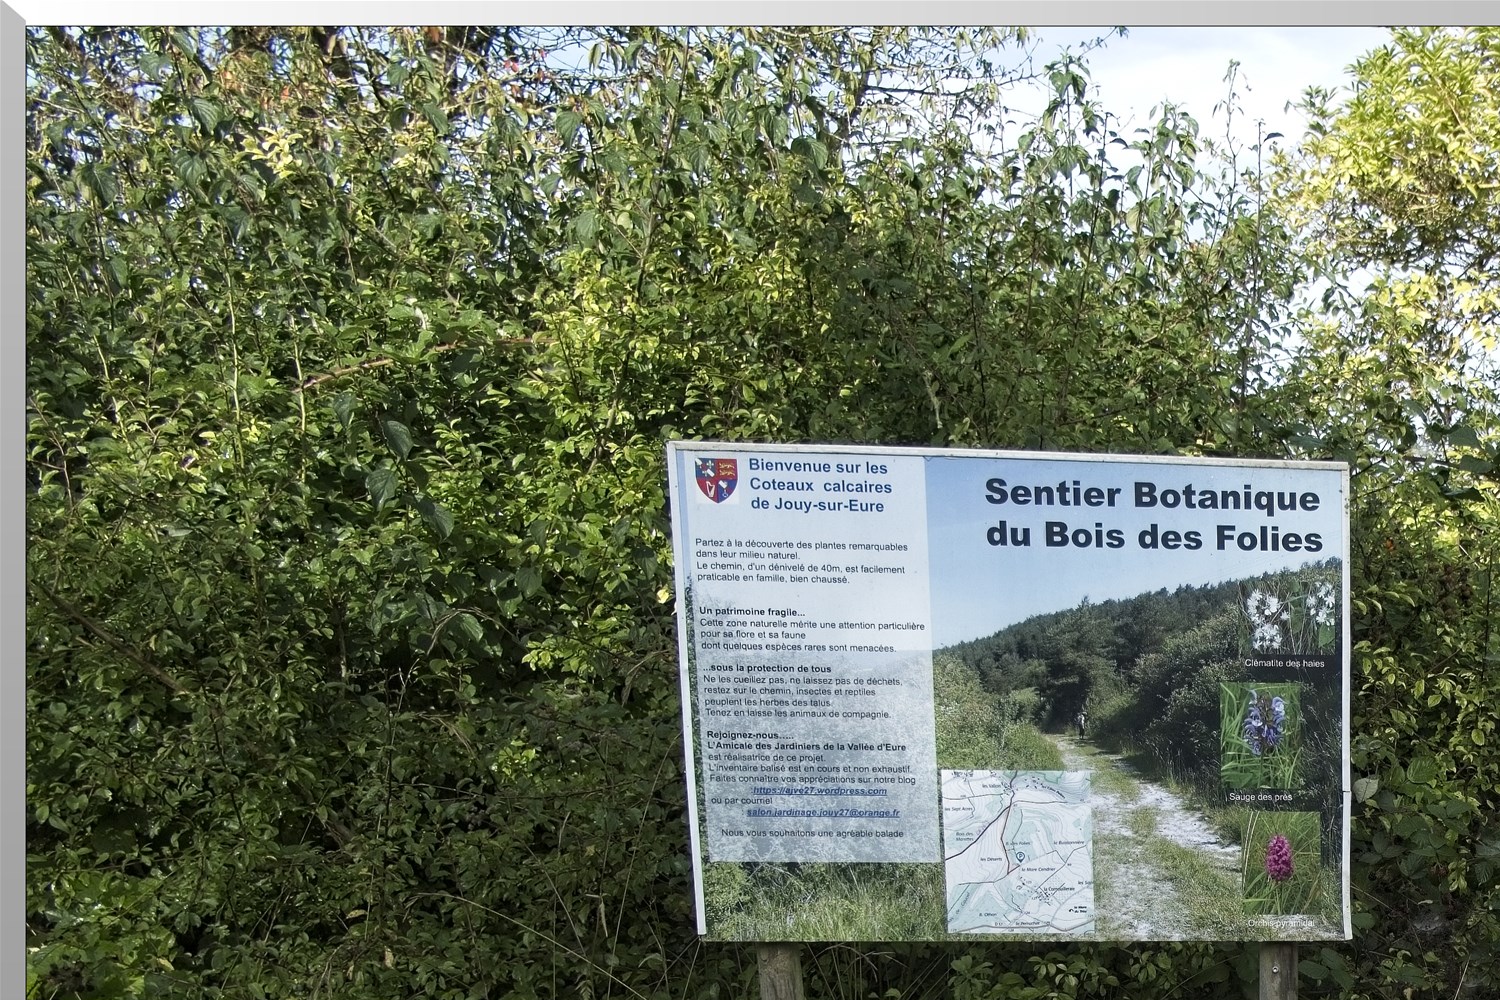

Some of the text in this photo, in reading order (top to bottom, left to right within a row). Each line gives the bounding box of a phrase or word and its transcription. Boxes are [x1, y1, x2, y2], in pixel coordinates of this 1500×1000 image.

[749, 458, 888, 474] Bienvenue sur les
[750, 478, 892, 493] Coteaux calcaires
[985, 478, 1320, 516] Sentier Botanique
[751, 497, 884, 513] de Jouy-sur-Eure
[987, 521, 1323, 552] du Bois des Folies
[696, 539, 724, 547] Partez
[727, 539, 732, 547] à
[745, 540, 794, 548] découverte
[797, 540, 812, 549] des
[815, 541, 846, 550] plantes
[849, 542, 908, 552] remarquables
[696, 550, 717, 558] dans
[720, 550, 736, 558] leur
[740, 551, 765, 559] milieu
[697, 562, 708, 570] Le
[711, 562, 744, 571] chemin,
[748, 563, 766, 571] d'un
[768, 563, 805, 572] dénivelé
[808, 564, 818, 572] de
[821, 564, 842, 573] 40m,
[861, 565, 905, 574] facilement
[697, 573, 740, 583] praticable
[756, 574, 787, 583] famille,
[790, 575, 808, 583] bien
[811, 575, 850, 584] chaussé.
[699, 607, 805, 617] Un patrimoine fragile...
[750, 620, 787, 628] naturelle
[790, 621, 817, 629] mérite
[878, 622, 925, 631] particulière
[701, 631, 720, 640] pour
[736, 631, 755, 639] flore
[758, 631, 766, 639] et
[702, 642, 720, 650] dont
[723, 643, 762, 652] quelques
[765, 643, 802, 652] espèces
[850, 644, 897, 653] menacées.
[1245, 659, 1325, 668] Clématite des haies
[736, 664, 744, 672] la
[747, 665, 795, 674] protection
[703, 675, 716, 683] Ne
[718, 675, 731, 683] les
[734, 676, 766, 684] cueillez
[803, 676, 832, 685] laissez
[835, 678, 851, 686] pas
[853, 677, 864, 685] de
[845, 688, 876, 697] reptiles
[705, 698, 742, 707] peuplent
[744, 698, 757, 706] les
[759, 698, 789, 706] herbes
[706, 709, 731, 717] Tenez
[747, 709, 772, 717] laisse
[790, 710, 826, 718] animaux
[829, 710, 839, 718] de
[842, 710, 891, 720] compagnie.
[708, 742, 752, 750] L'Amicale
[756, 742, 771, 750] des
[775, 743, 820, 751] Jardiniers
[837, 743, 845, 751] la
[848, 743, 874, 751] Vallée
[773, 754, 784, 762] de
[799, 754, 826, 763] projet.
[709, 764, 758, 772] L'inventaire
[760, 764, 786, 772] balisé
[739, 775, 778, 783] connaître
[799, 775, 856, 785] appréciations
[898, 777, 916, 785] blog
[725, 798, 739, 806] par
[1229, 793, 1292, 804] Sauge des prés
[836, 830, 873, 839] agréable
